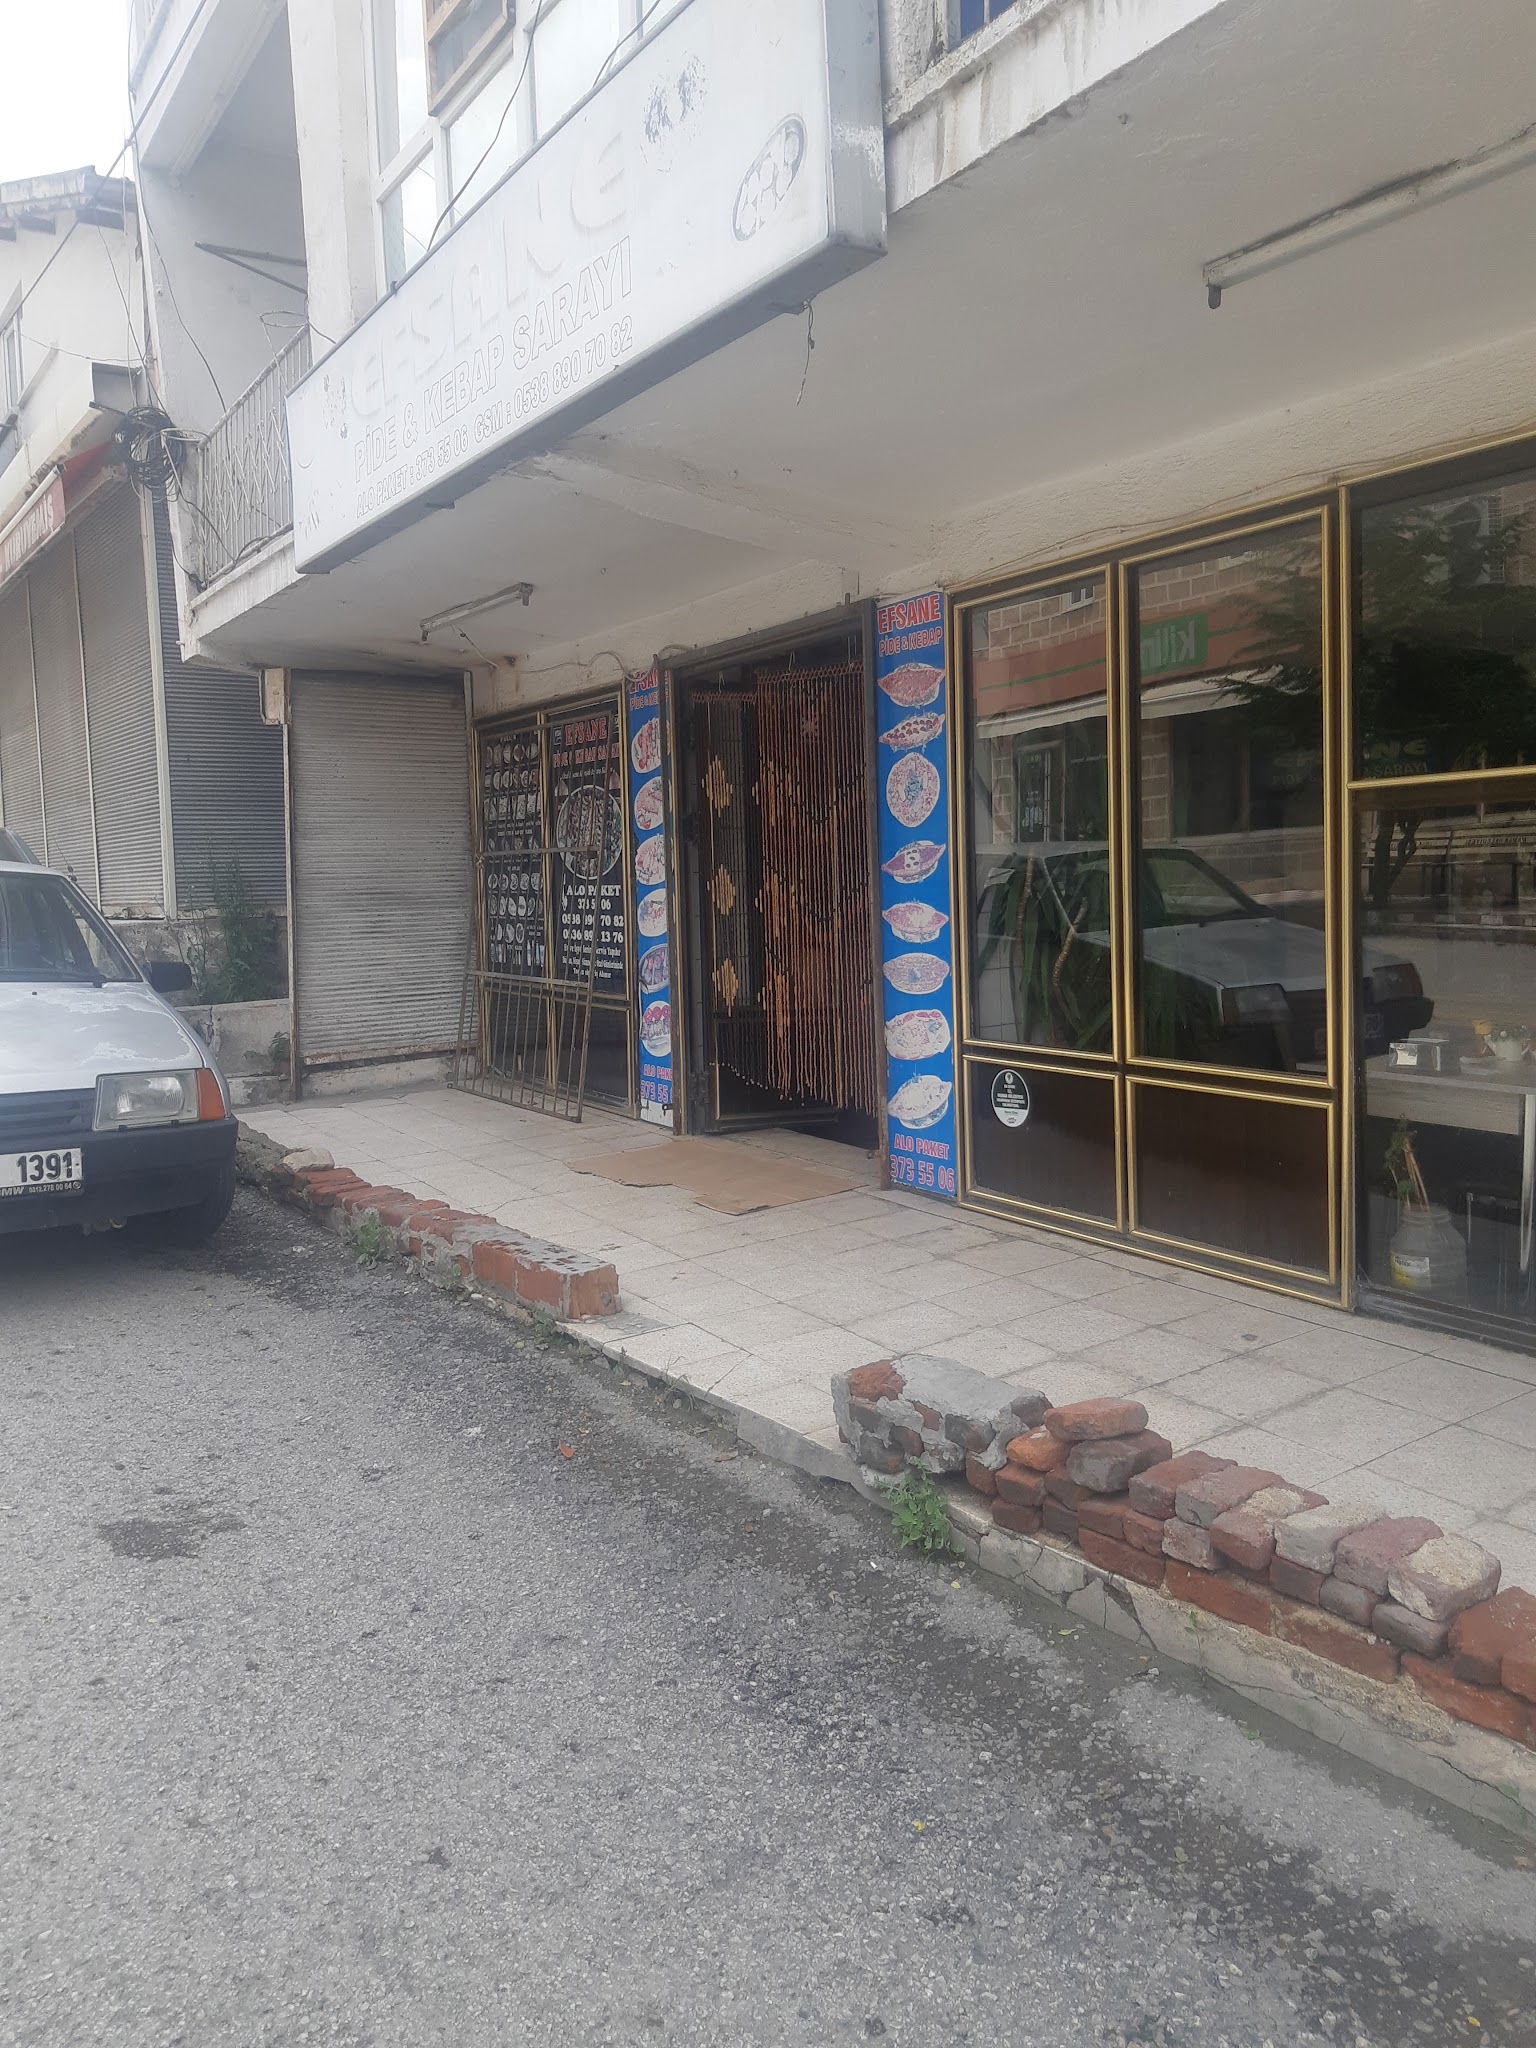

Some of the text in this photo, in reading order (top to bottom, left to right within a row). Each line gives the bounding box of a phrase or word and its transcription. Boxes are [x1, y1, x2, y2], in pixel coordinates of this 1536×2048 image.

[354, 234, 632, 483] PİDE & KEBAP SARAYI
[357, 485, 375, 519] ALO
[376, 463, 409, 506] PAKET
[415, 445, 436, 481] 373
[437, 434, 451, 468] 55
[453, 424, 469, 457] 06
[474, 400, 504, 444] GSM
[513, 370, 549, 419] 0538
[552, 349, 582, 395] 890
[584, 332, 606, 374] 70
[610, 315, 633, 358] 82
[878, 593, 942, 635] EFSANE
[879, 626, 943, 657] PİDE & KEBAP
[566, 885, 586, 896] ALO
[600, 899, 612, 910] 06
[600, 915, 611, 926] 70
[613, 915, 624, 927] 82
[583, 930, 594, 941] 89
[600, 931, 611, 942] 13
[612, 931, 624, 943] 76
[643, 1064, 656, 1077] ALO
[640, 1080, 669, 1104] 373 55
[894, 1133, 949, 1160] ALO PAKET
[17, 1151, 73, 1183] 1391
[889, 1154, 955, 1192] 373 55 06
[0, 1186, 24, 1197] MW
